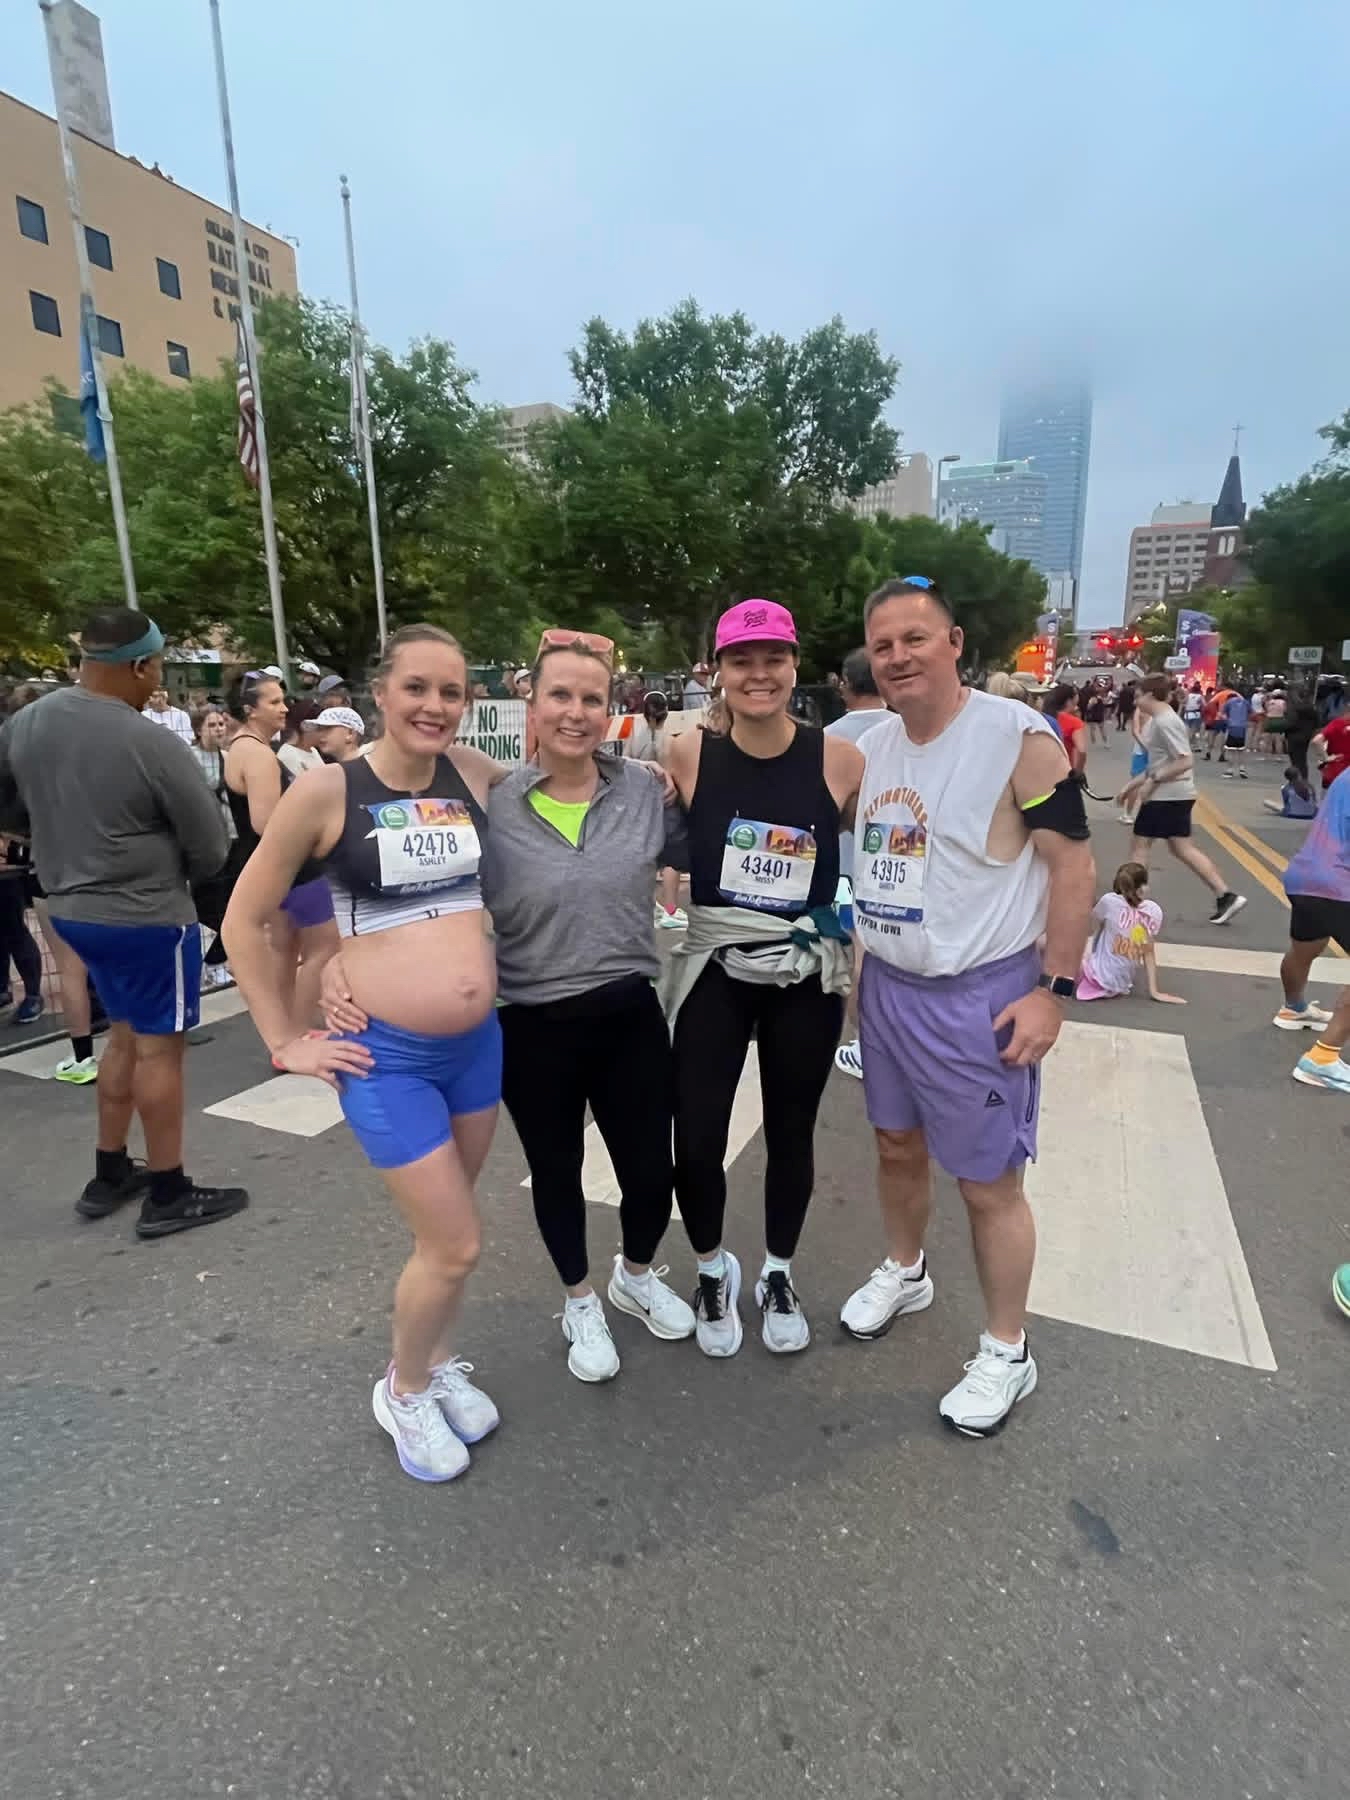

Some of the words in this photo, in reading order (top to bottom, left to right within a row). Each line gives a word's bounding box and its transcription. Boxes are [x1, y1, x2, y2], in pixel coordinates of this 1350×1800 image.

[205, 218, 252, 254] OKLAHOA
[252, 243, 270, 263] CITY
[207, 240, 273, 289] NATINAL
[1044, 622, 1056, 684] START
[1175, 620, 1191, 685] STAT
[478, 705, 498, 733] NO
[455, 734, 521, 761] NDING
[402, 831, 458, 858] 42478
[418, 856, 446, 867] ASHLEY
[740, 855, 792, 880] 43401
[871, 859, 906, 884] 43915
[880, 922, 902, 936] IOWA
